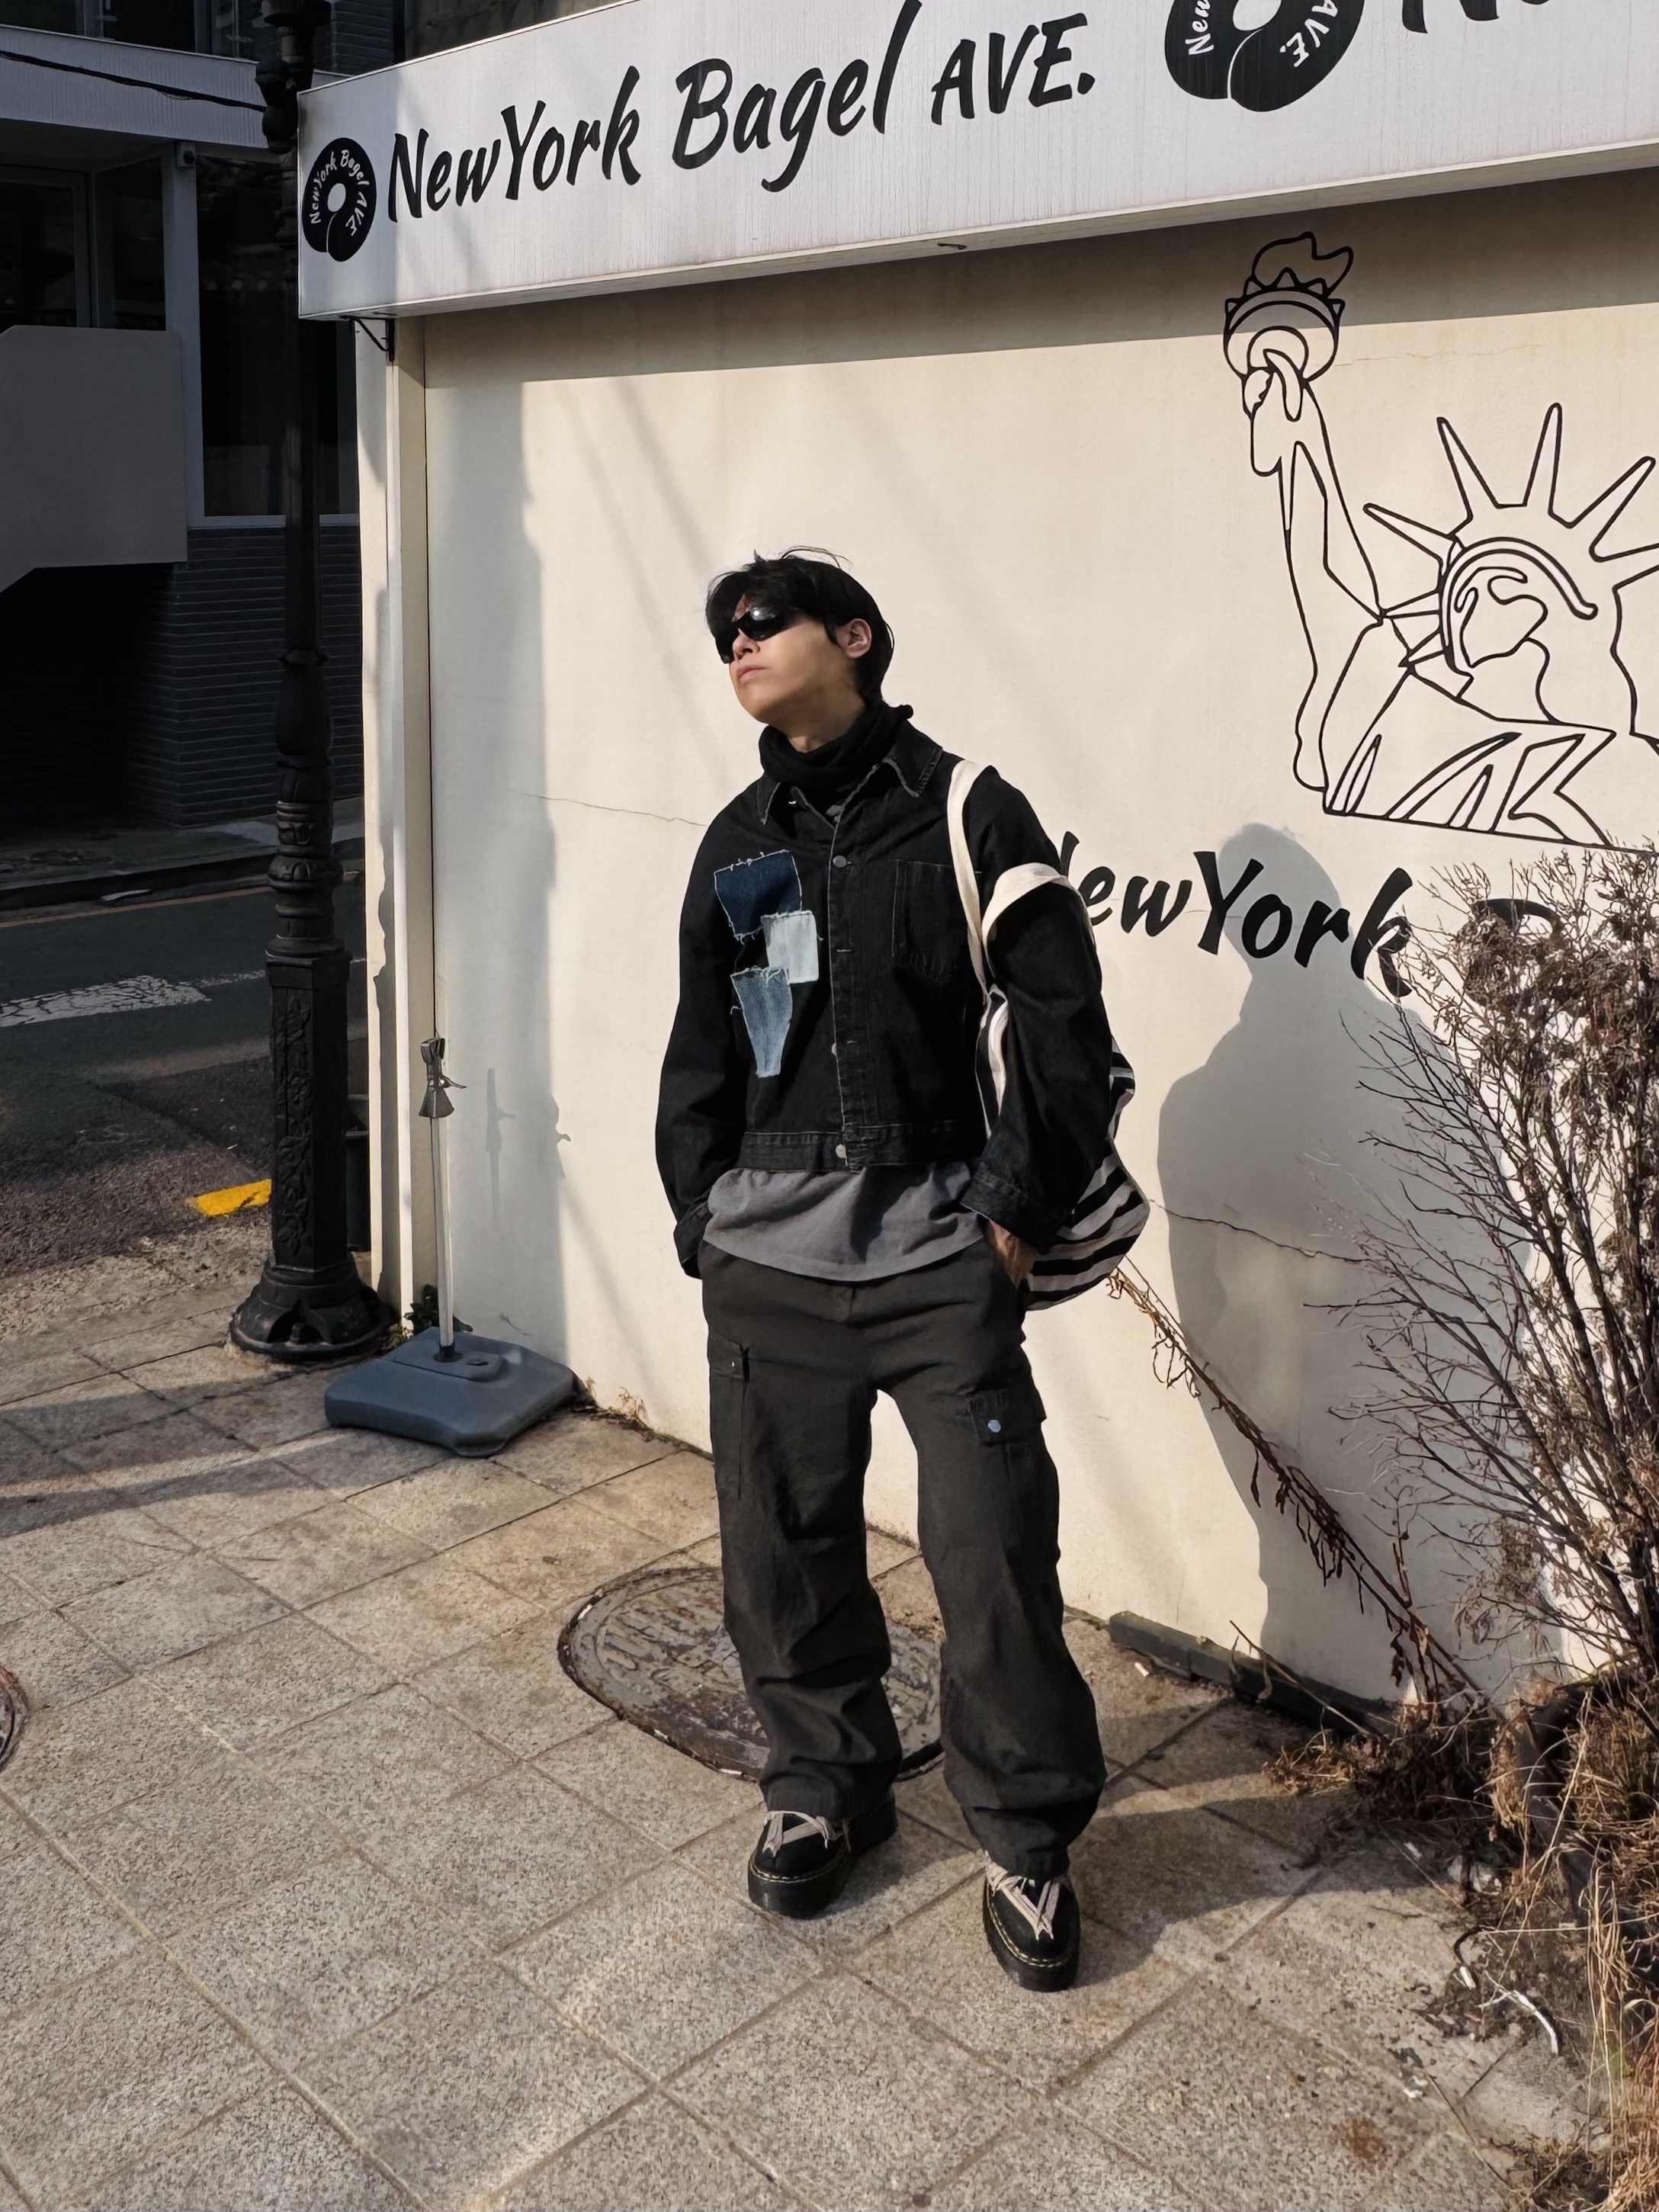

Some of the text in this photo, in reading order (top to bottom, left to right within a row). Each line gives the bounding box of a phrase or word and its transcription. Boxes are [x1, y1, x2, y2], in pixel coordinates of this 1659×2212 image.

[340, 149, 369, 185] Bagel
[388, 0, 1095, 223] NewYork Bagel AVE.
